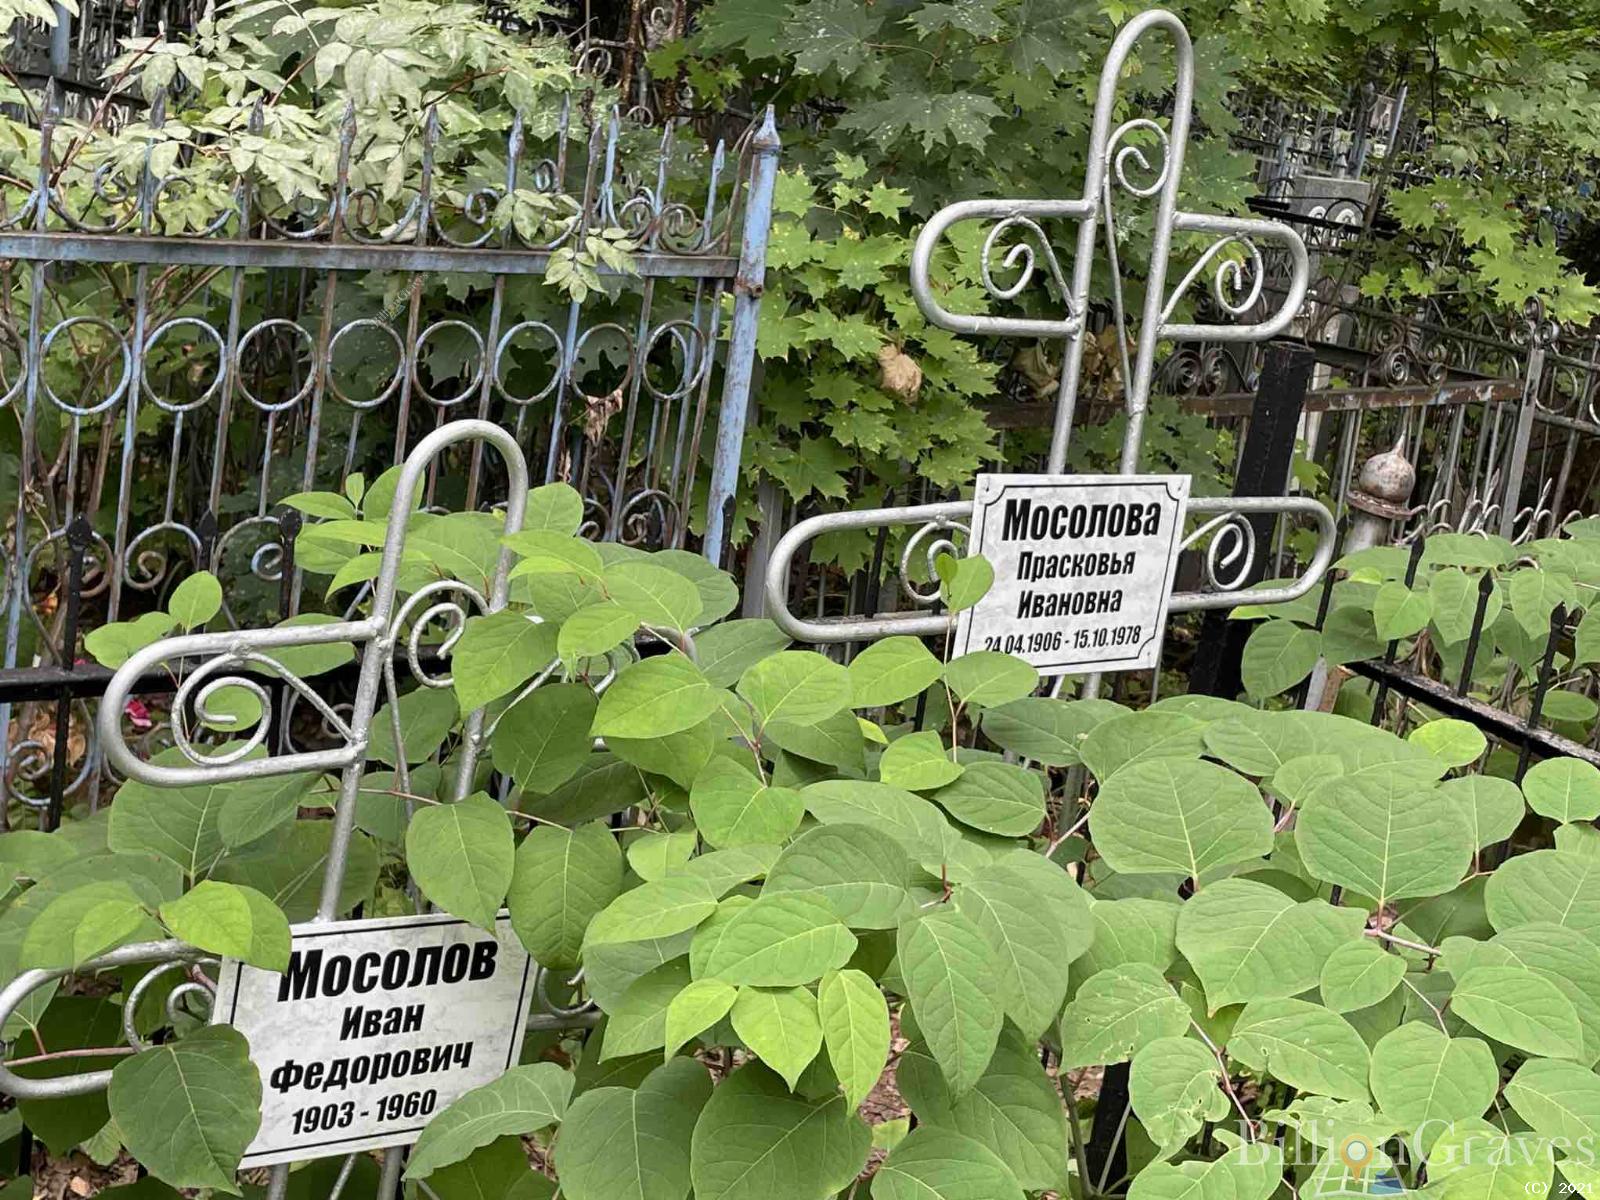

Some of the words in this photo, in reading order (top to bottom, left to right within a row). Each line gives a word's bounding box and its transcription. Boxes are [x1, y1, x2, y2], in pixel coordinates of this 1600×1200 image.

[1002, 498, 1162, 541] Мосолова
[1017, 551, 1136, 582] Прасковья
[1017, 589, 1123, 619] Ивановна
[1073, 625, 1142, 649] 15.10.1978
[277, 941, 498, 1002] Мосолов
[339, 1004, 425, 1041] Иван
[270, 1042, 474, 1094] Федорович
[292, 1101, 355, 1135] 1903
[377, 1089, 437, 1122] 1960
